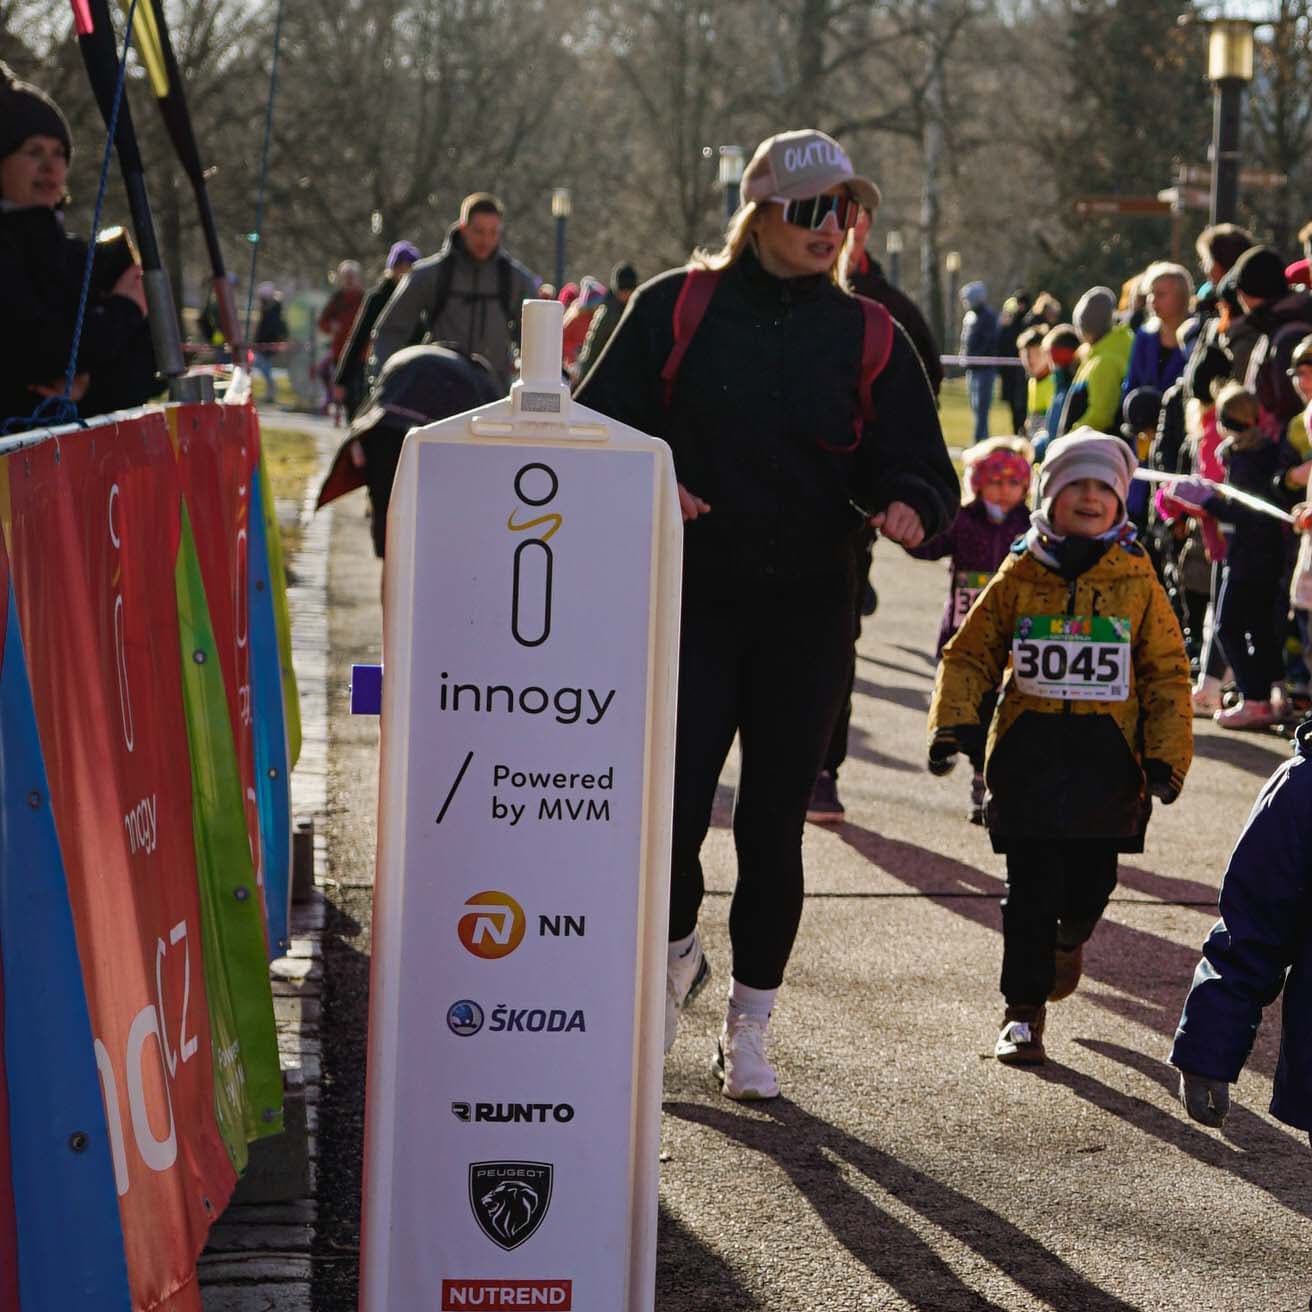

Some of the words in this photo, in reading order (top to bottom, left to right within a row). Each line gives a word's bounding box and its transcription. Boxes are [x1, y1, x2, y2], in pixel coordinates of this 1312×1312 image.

[785, 141, 853, 175] OUTL
[1017, 643, 1120, 682] 3045
[441, 672, 616, 725] innogy
[493, 764, 614, 790] Powered
[492, 795, 525, 826] by
[538, 798, 610, 822] MVM
[538, 914, 585, 937] NN
[488, 1003, 586, 1033] ŠKODA
[475, 1102, 575, 1123] RUNTO
[477, 1169, 545, 1178] PEUGEOT
[450, 1287, 566, 1305] NUTREND
